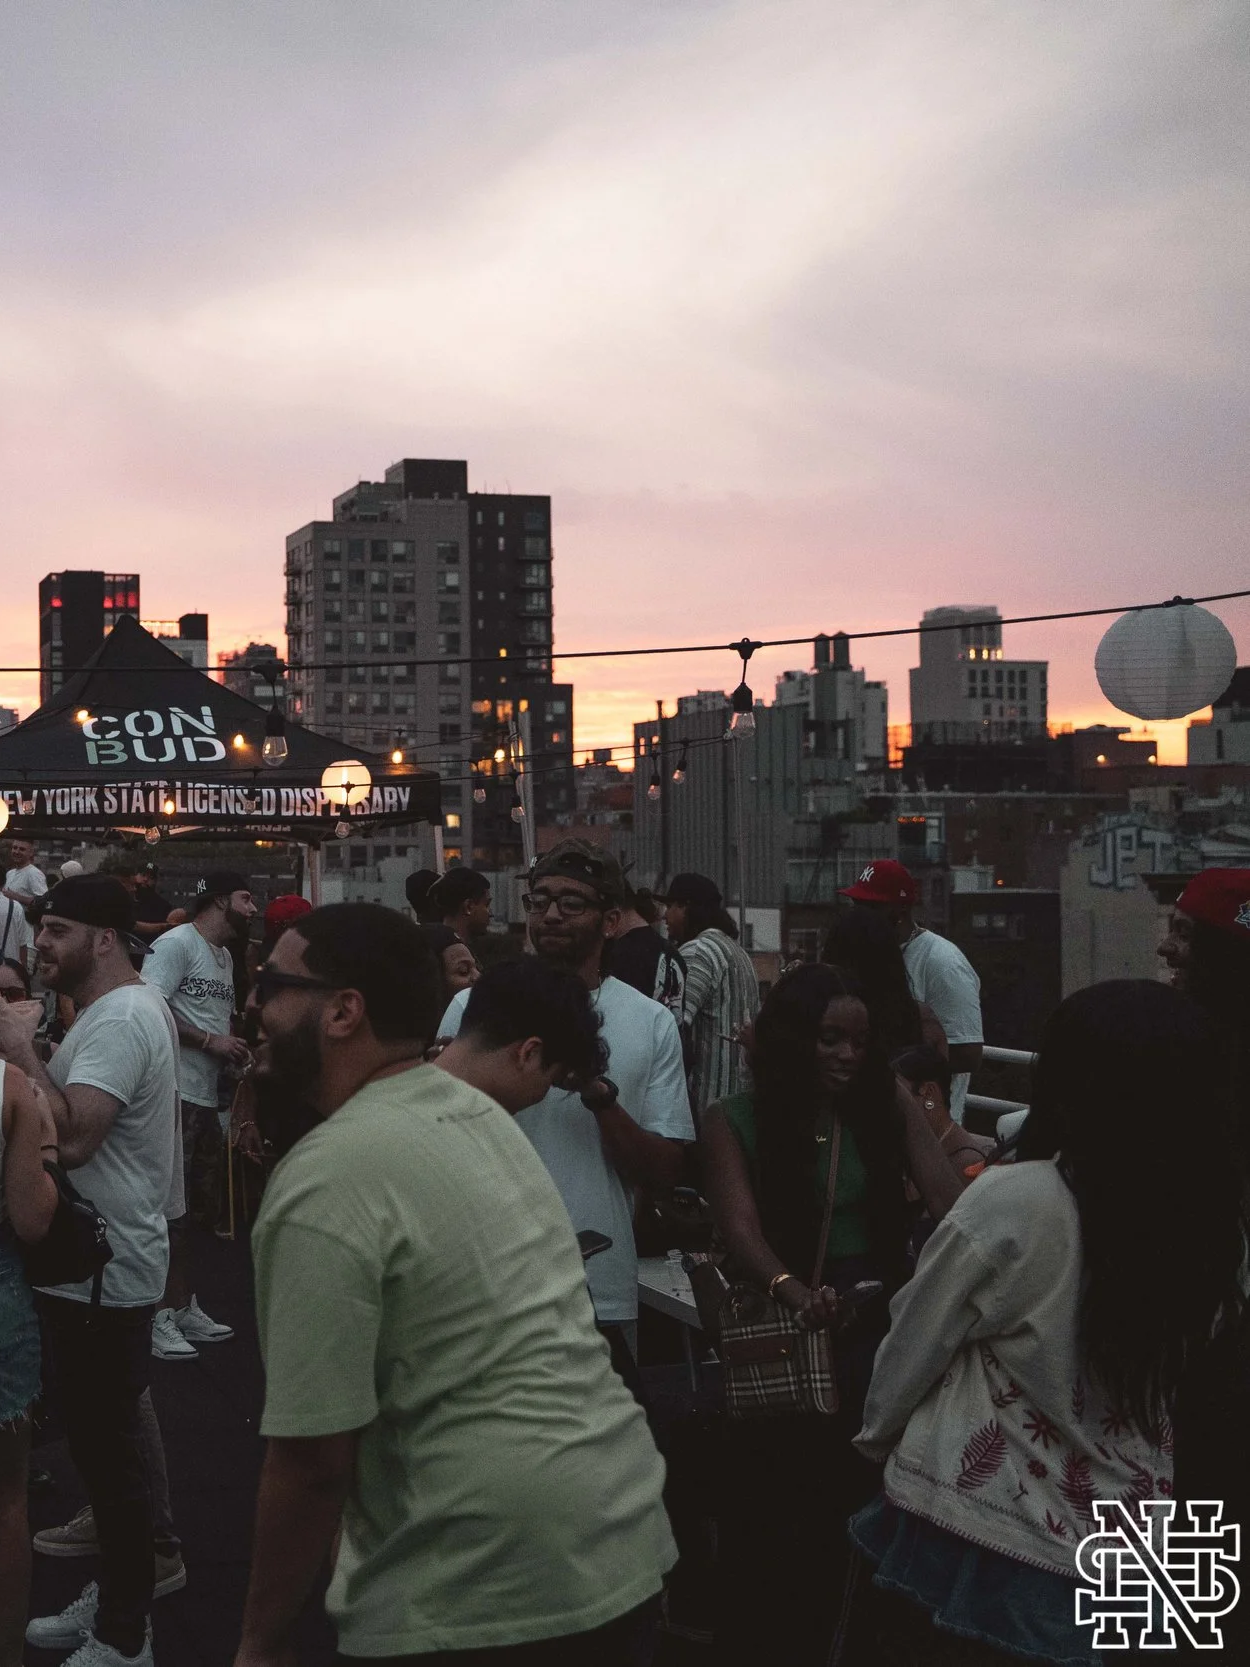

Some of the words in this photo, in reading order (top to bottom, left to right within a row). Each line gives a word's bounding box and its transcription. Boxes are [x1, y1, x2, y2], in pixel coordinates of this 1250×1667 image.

[82, 706, 217, 739] CON
[85, 737, 226, 764] BUD
[42, 786, 100, 815] YORK
[104, 780, 173, 815] STATE
